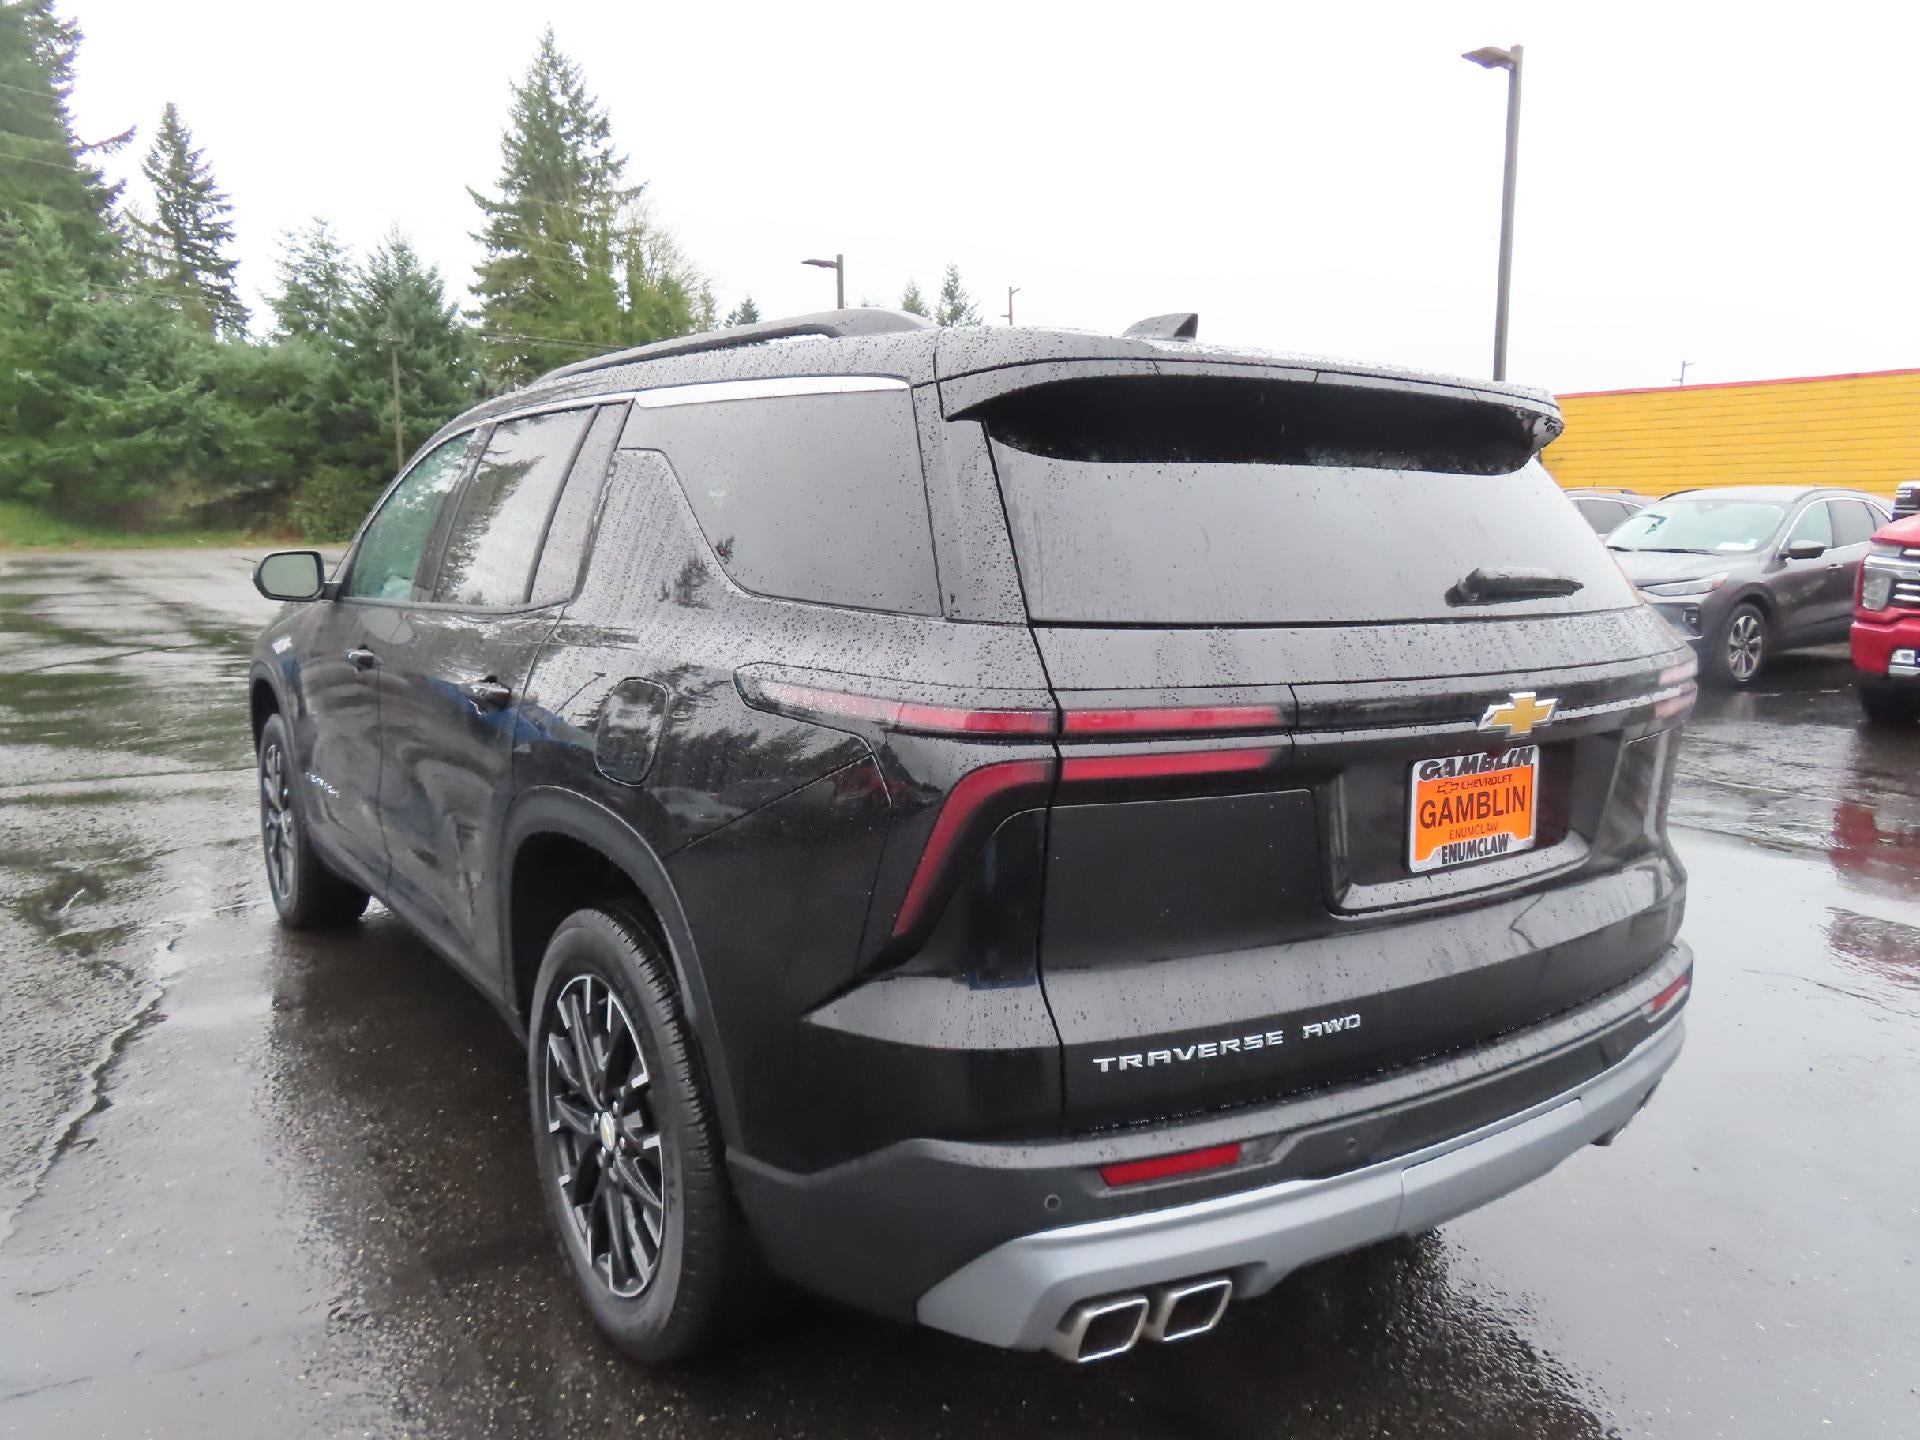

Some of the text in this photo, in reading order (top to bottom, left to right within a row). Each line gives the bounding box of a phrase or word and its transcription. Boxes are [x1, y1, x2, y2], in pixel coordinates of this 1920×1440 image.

[1419, 747, 1535, 780] GAMBLIN
[1461, 774, 1512, 790] CHEVROLET
[1420, 785, 1526, 829] GAMBLIN
[1449, 821, 1498, 840] ENUMCLAW
[1441, 834, 1510, 865] ENUMCLAW
[1092, 1013, 1361, 1073] TRAVERSE AWD
